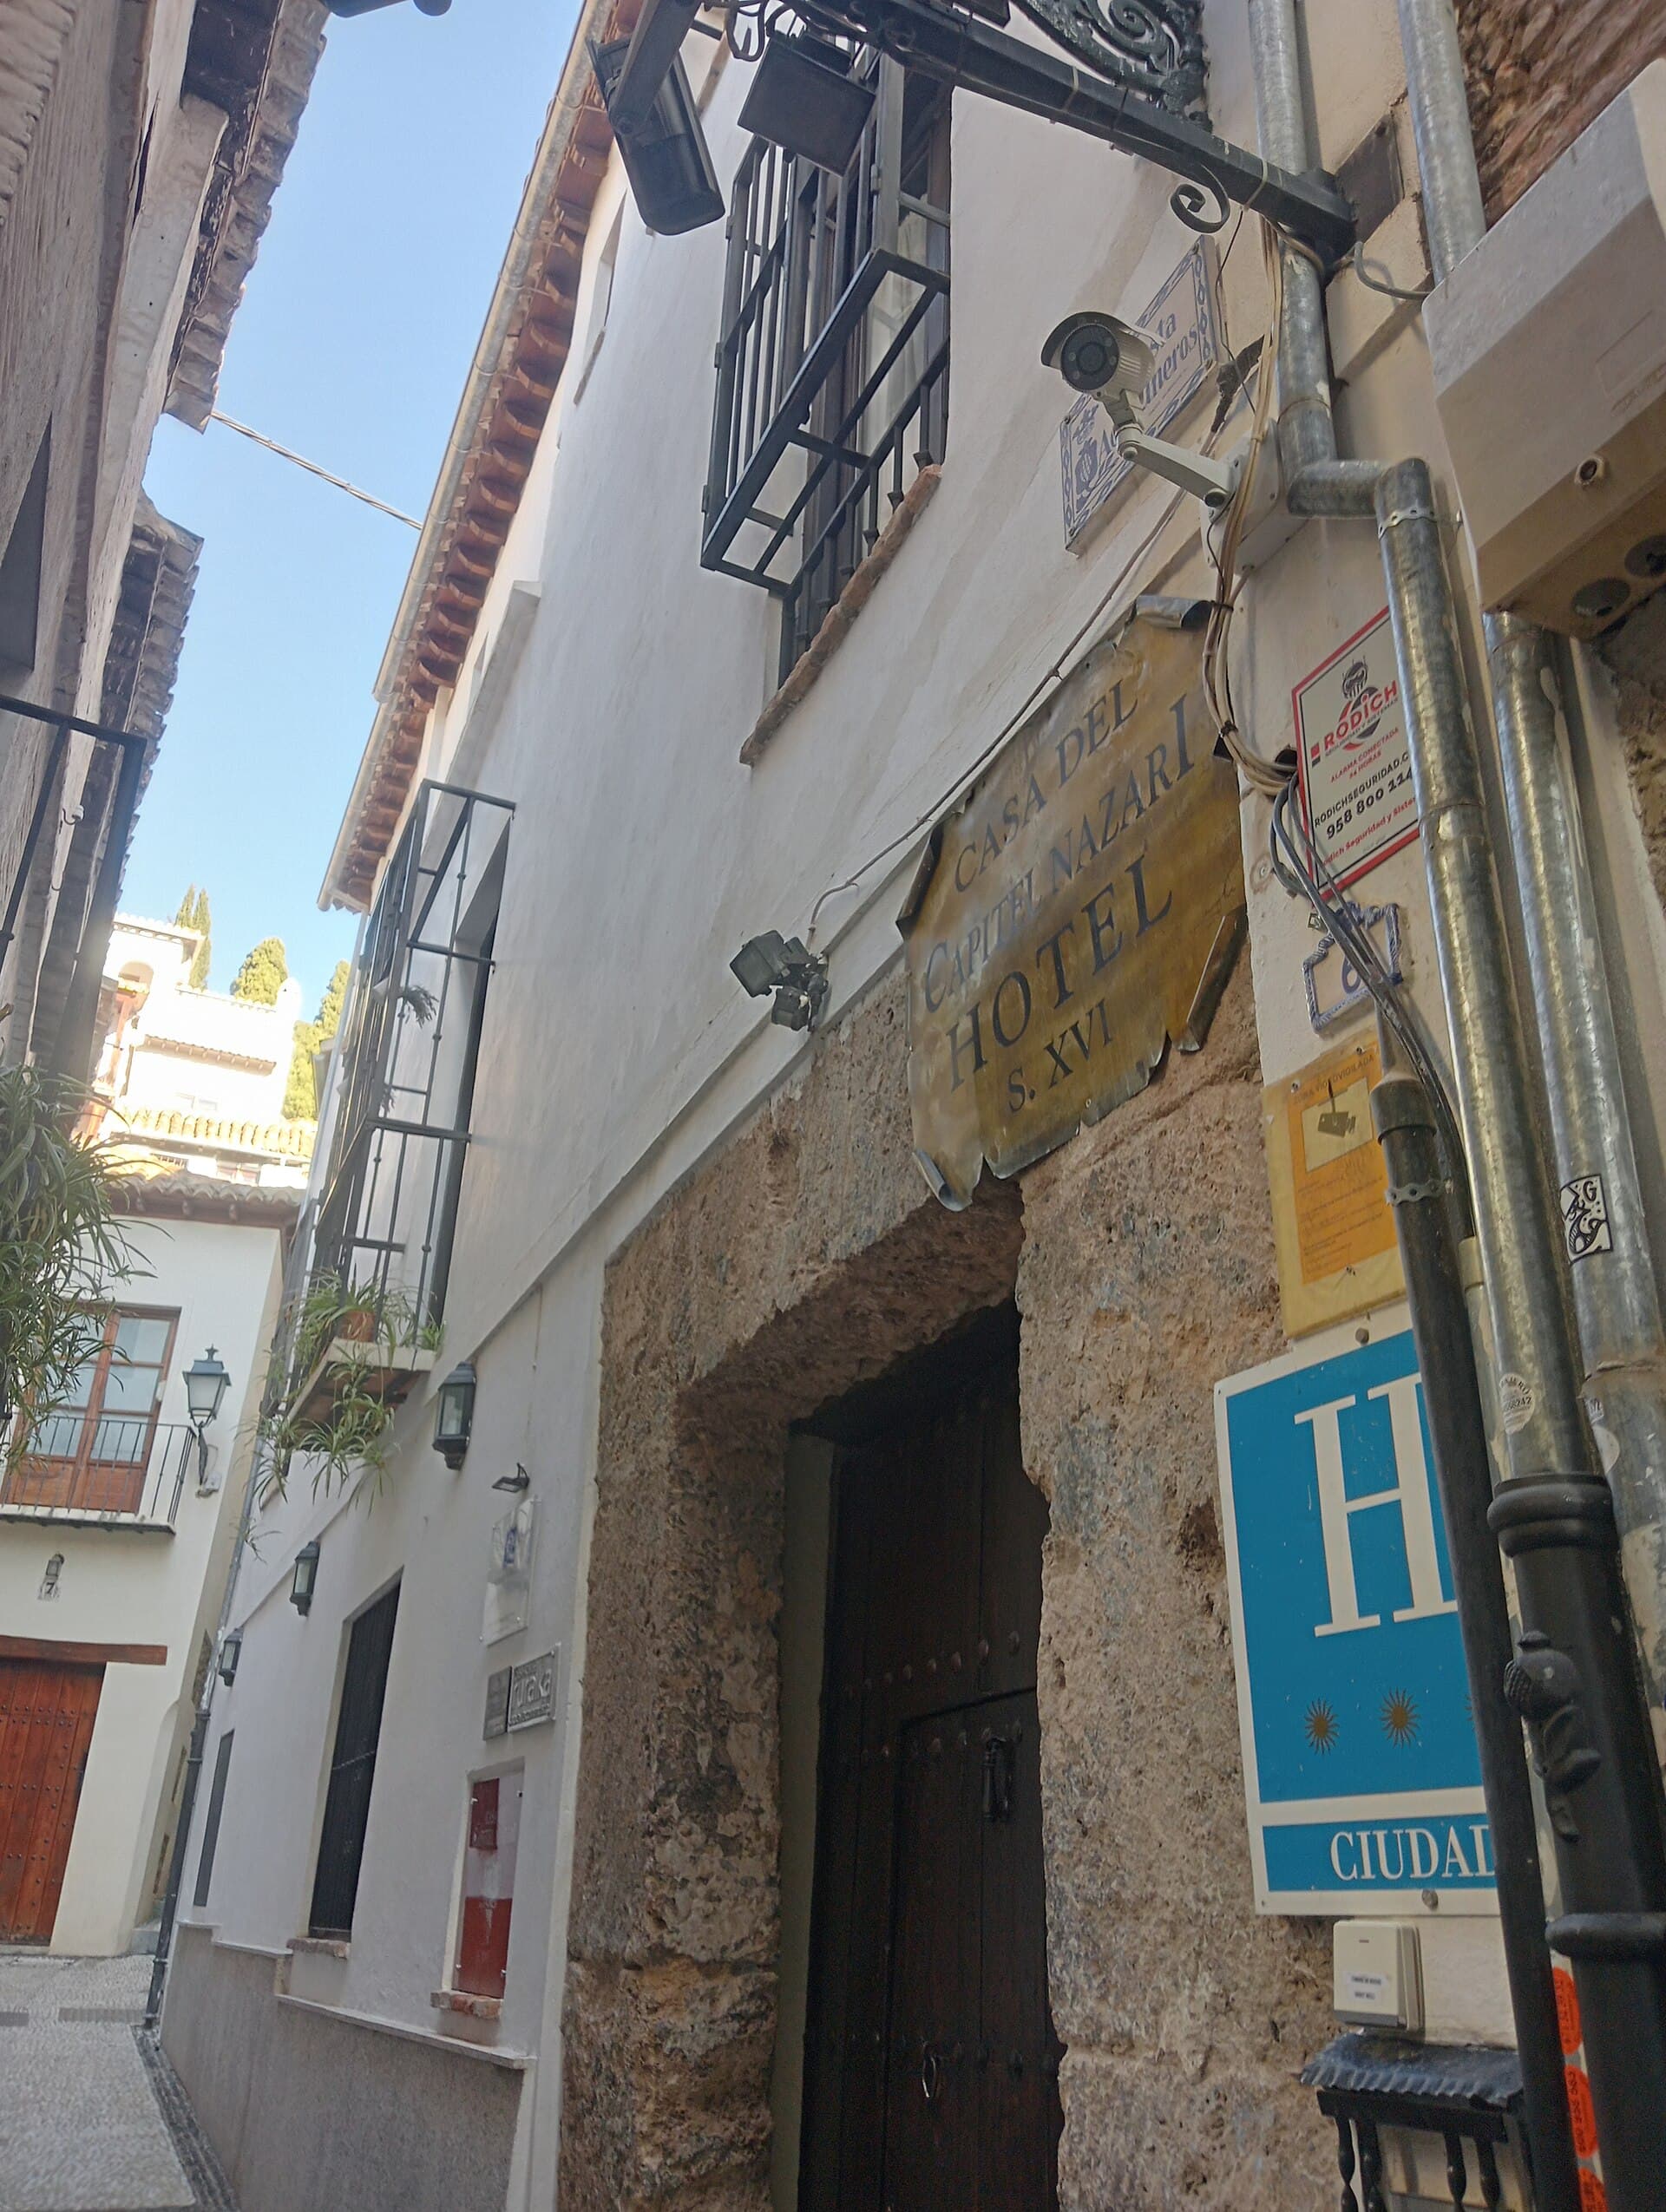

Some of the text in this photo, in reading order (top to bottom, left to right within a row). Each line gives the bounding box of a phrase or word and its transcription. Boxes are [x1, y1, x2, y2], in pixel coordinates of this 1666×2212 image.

[955, 679, 1138, 893] CASA DEL
[1314, 750, 1410, 828] RODICHSEGURIDAD.C
[1323, 847, 1345, 866] odich
[1393, 797, 1416, 816] Siste
[1326, 808, 1353, 841] 958
[1356, 788, 1384, 815] 800
[923, 870, 1041, 1013] CAPITEL
[946, 853, 1173, 1092] HOTEL
[1047, 998, 1114, 1090] XVI
[1316, 1054, 1374, 1092] VIDOVIGILADA
[1294, 1373, 1459, 1638] H
